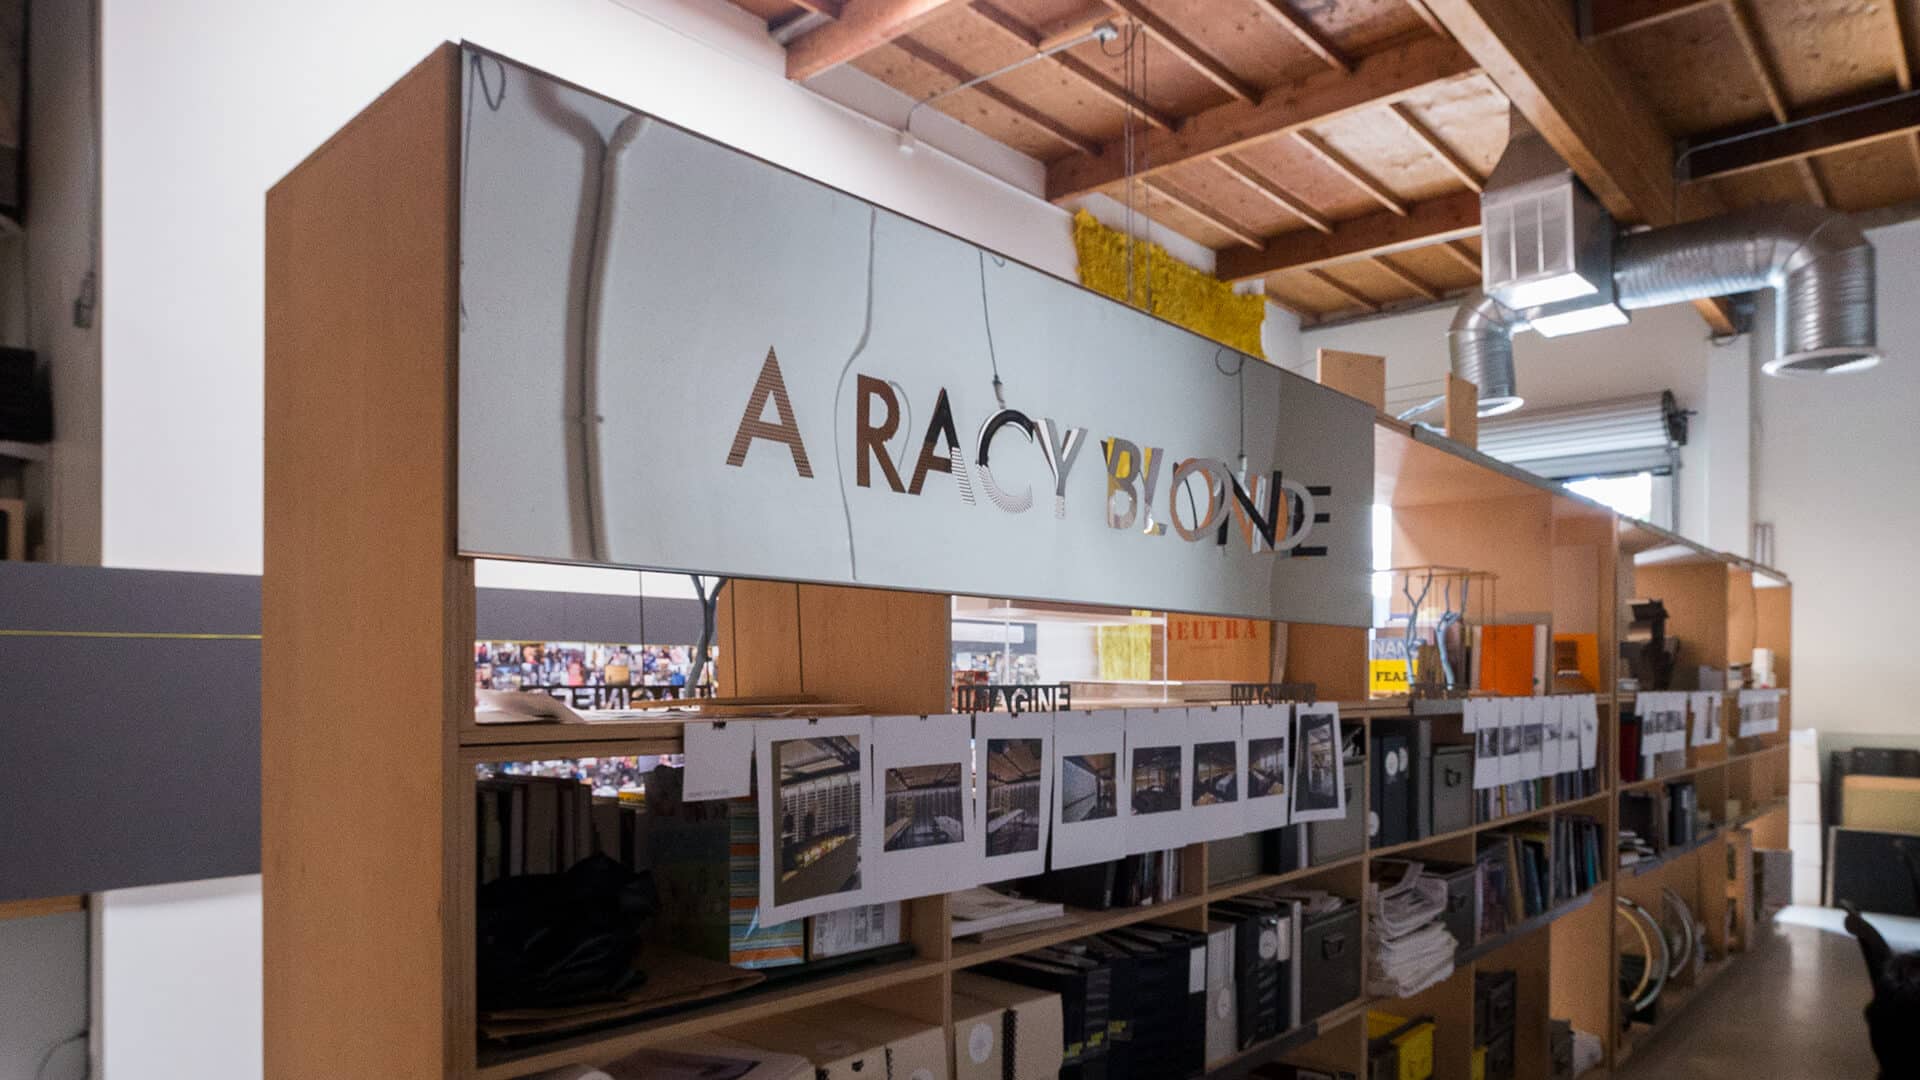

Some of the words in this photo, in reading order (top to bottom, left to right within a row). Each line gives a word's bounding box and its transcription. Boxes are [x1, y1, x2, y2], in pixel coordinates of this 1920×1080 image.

[726, 344, 814, 479] A
[856, 373, 1088, 520] RACY
[1100, 436, 1332, 558] BLONDE
[959, 685, 1070, 713] IMAGINE
